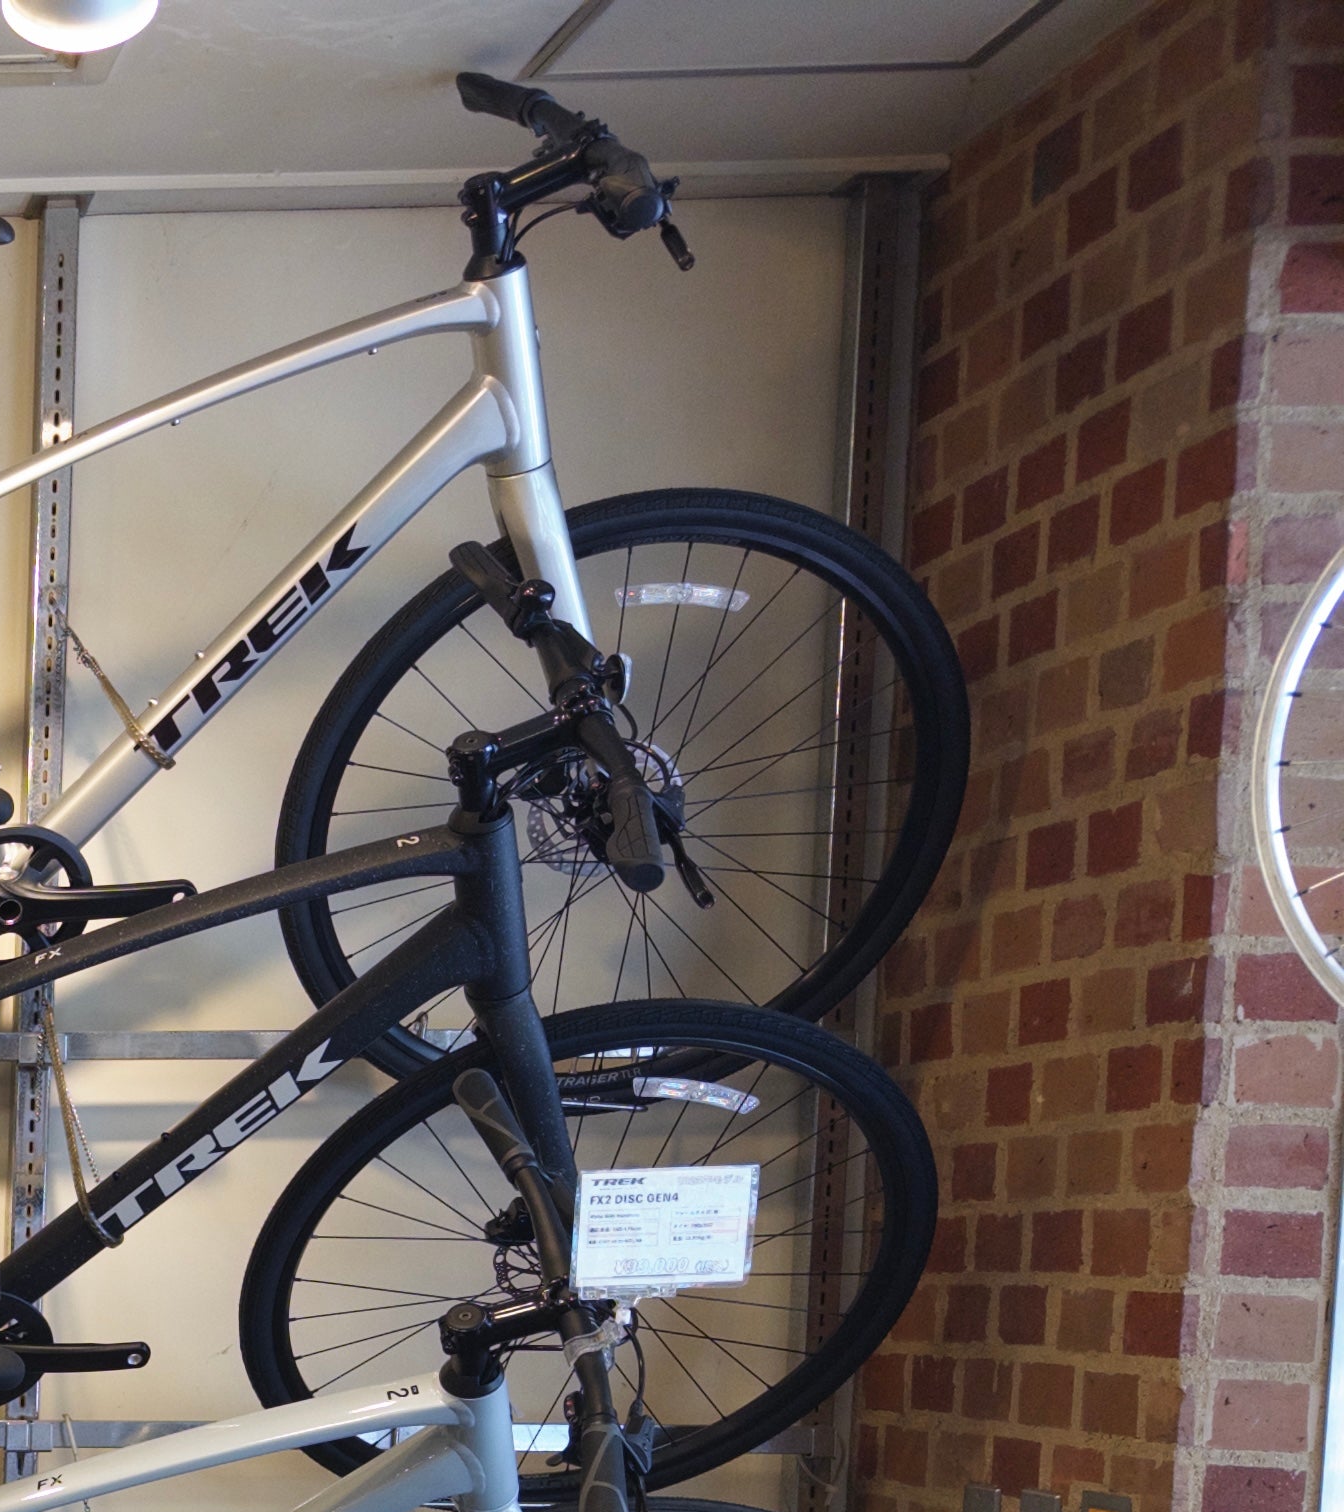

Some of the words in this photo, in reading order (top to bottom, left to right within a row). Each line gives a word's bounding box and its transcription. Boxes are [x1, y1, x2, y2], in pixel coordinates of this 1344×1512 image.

[134, 520, 370, 753] TREK
[34, 946, 62, 965] FX
[98, 1038, 344, 1228] TREK
[591, 1177, 647, 1187] TREK
[590, 1195, 612, 1206] FX2
[615, 1194, 643, 1204] DISC
[646, 1193, 679, 1203] GEN4
[387, 1387, 410, 1400] 2
[37, 1474, 63, 1492] FX
